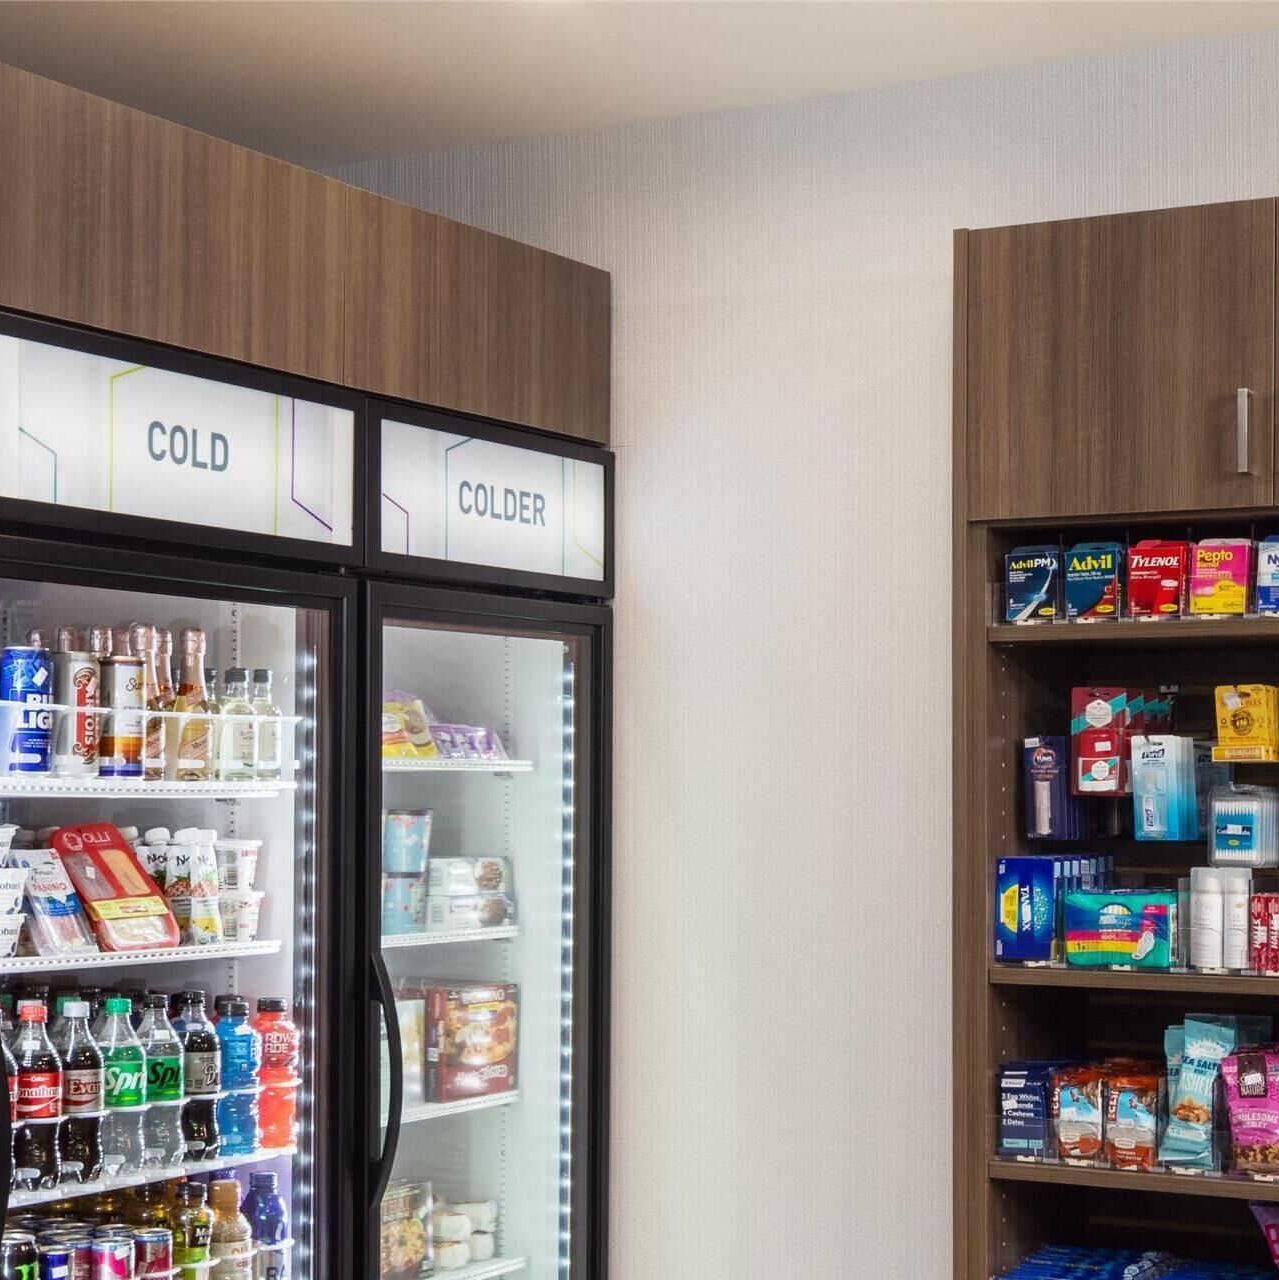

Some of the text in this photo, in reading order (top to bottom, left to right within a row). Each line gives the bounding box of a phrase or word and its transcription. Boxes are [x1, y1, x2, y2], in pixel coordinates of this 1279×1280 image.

[147, 420, 229, 473] COLD
[458, 480, 547, 527] COLDER
[1131, 555, 1180, 568] TYLENOL
[1196, 549, 1233, 562] Pepto
[1009, 557, 1051, 570] Advil PM
[1070, 555, 1112, 571] Advil
[17, 710, 54, 729] LIG
[83, 831, 110, 844] OLLI
[105, 1067, 146, 1096] Spri
[1240, 1085, 1266, 1096] NATURE
[1008, 1110, 1034, 1118] Cashews
